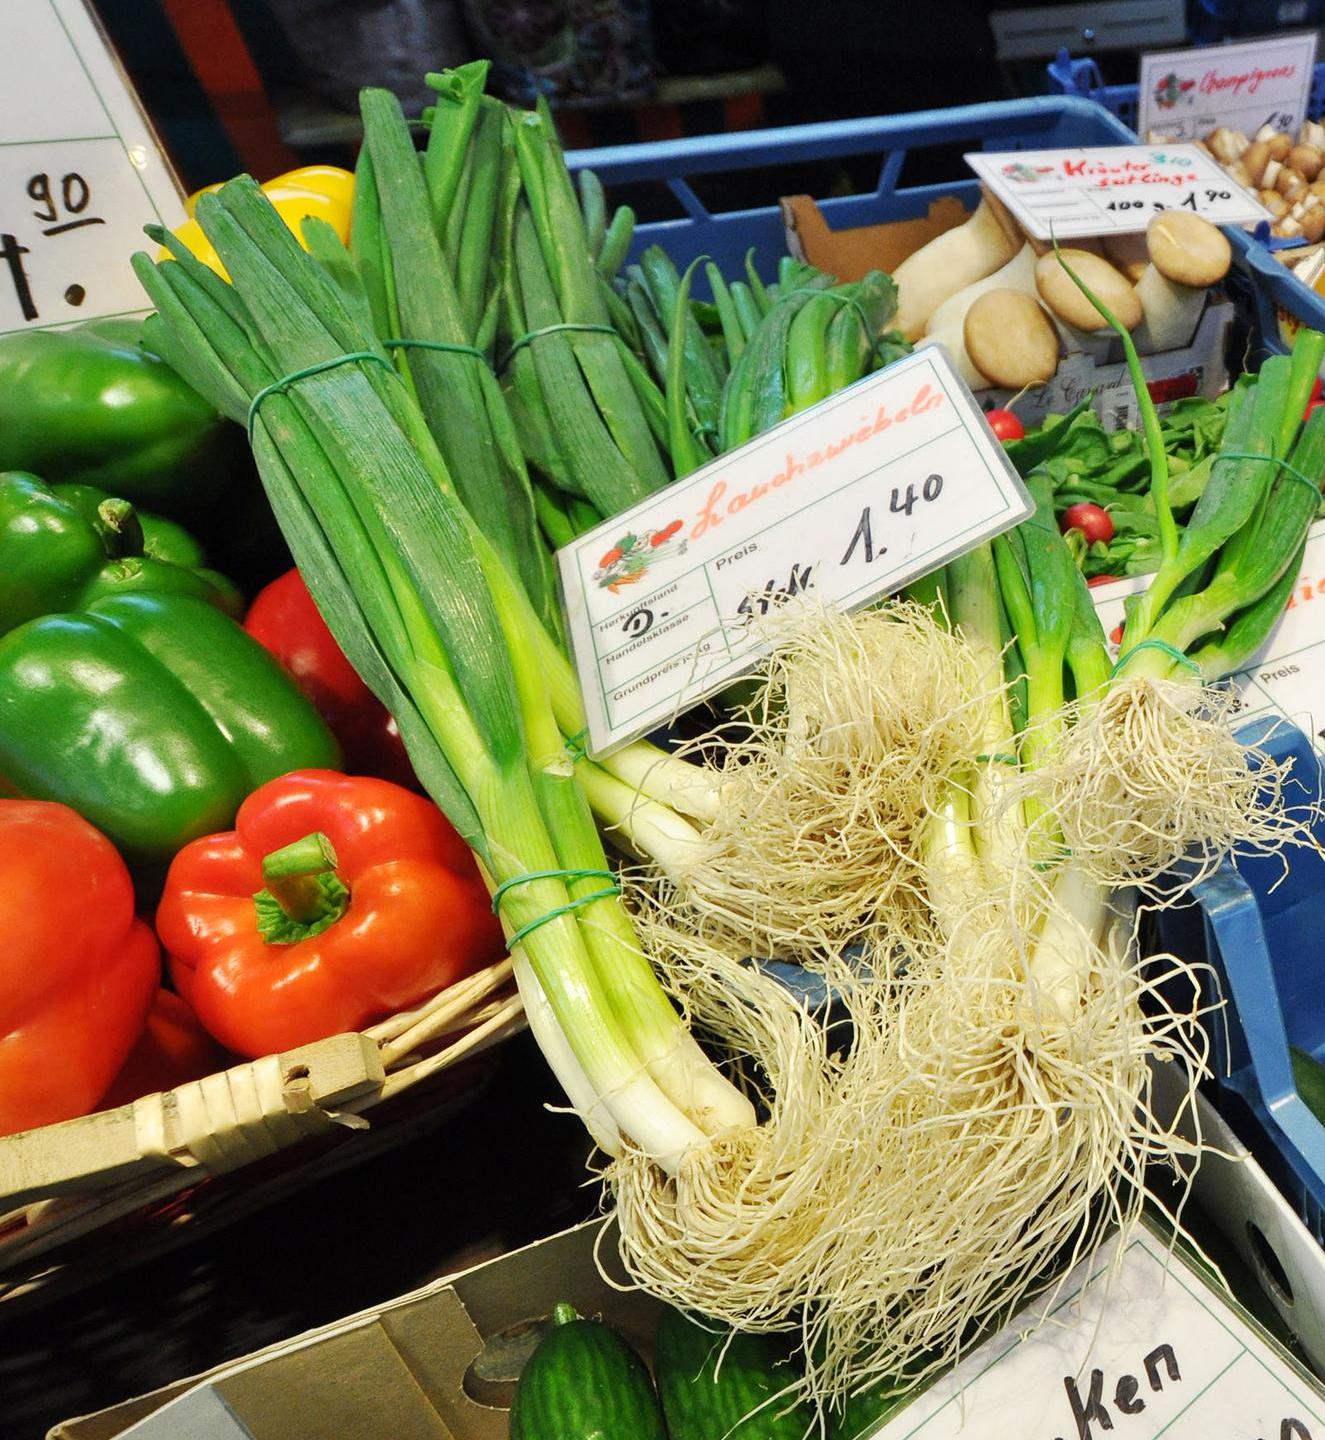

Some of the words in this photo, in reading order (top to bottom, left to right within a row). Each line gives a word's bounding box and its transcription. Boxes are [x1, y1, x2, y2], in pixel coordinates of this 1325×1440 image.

[1106, 200, 1145, 211] 100
[714, 541, 758, 572] Preis
[598, 583, 679, 633] Herkunftsland
[605, 614, 689, 665] Handelsklasse
[612, 657, 680, 702] Grundpreis
[1259, 664, 1301, 685] Preis
